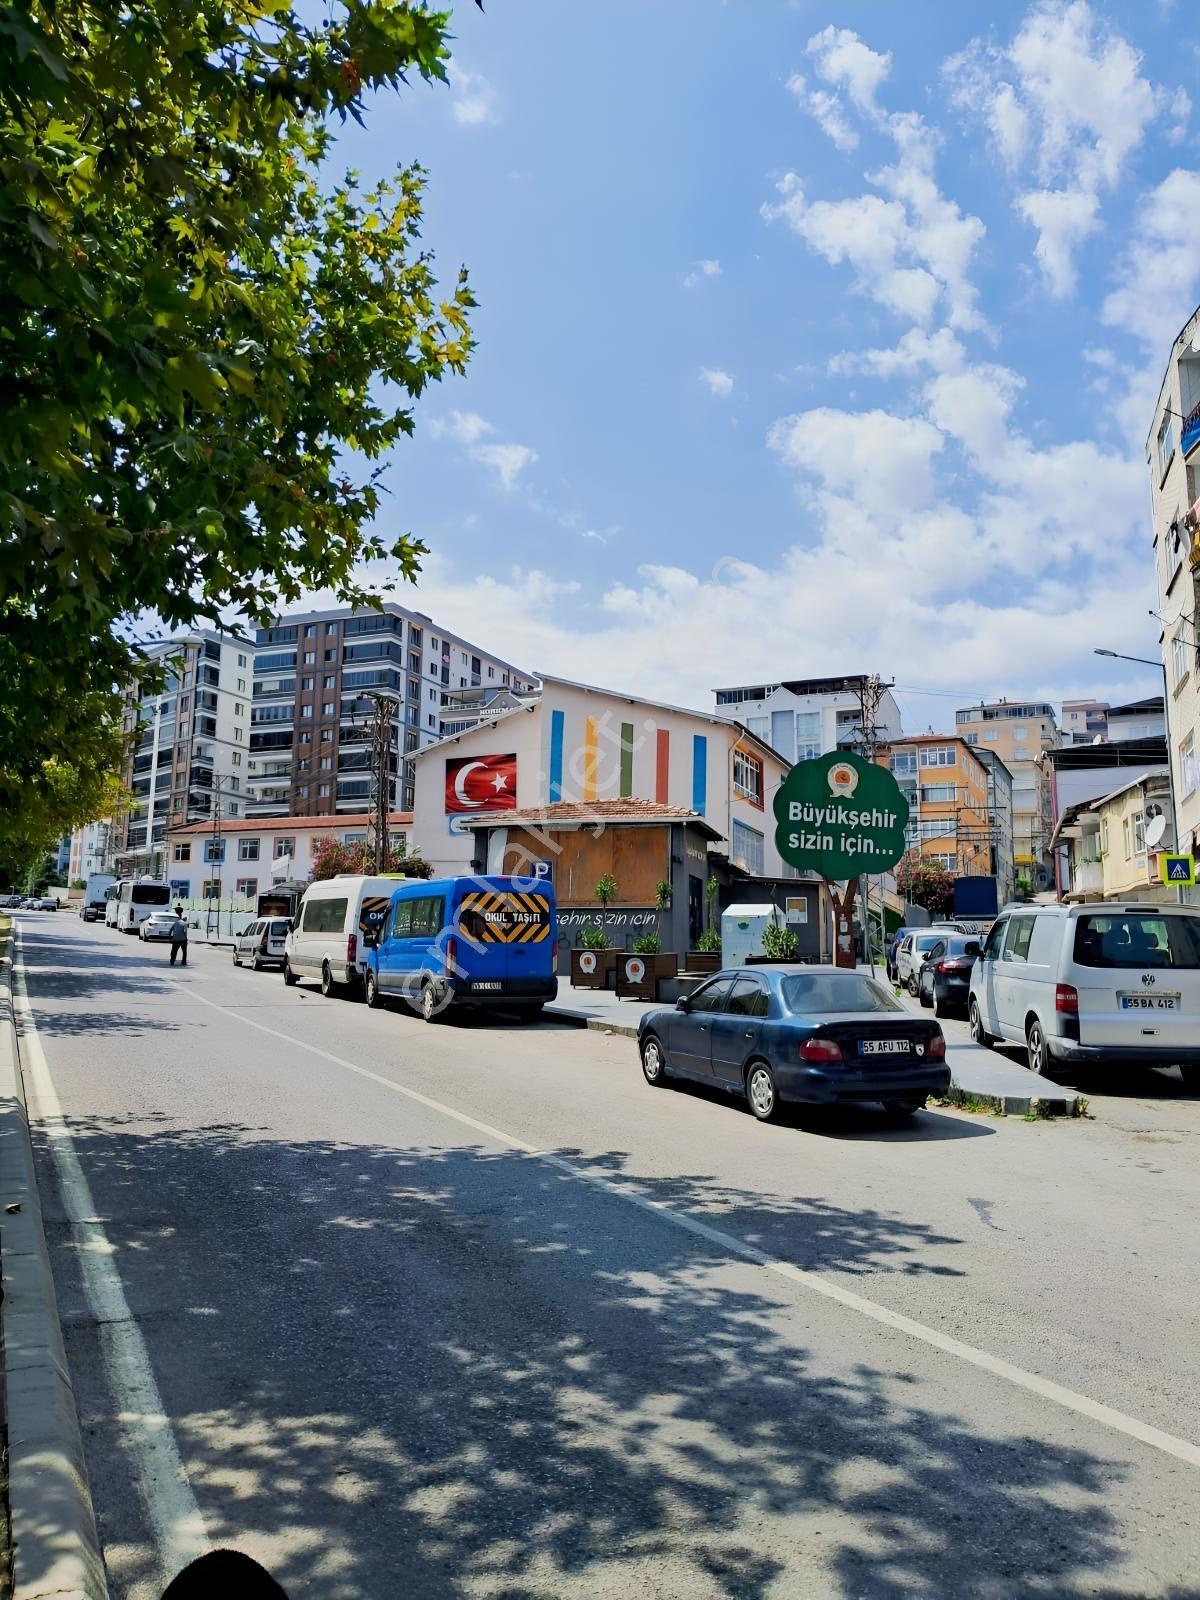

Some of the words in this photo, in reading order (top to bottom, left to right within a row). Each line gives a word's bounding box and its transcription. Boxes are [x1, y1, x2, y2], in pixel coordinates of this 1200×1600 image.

[788, 801, 897, 830] Büyükşehir
[788, 830, 834, 851] sizin
[840, 833, 894, 857] için...
[534, 863, 549, 878] P
[369, 912, 384, 920] OK
[484, 912, 508, 922] OKUL
[1127, 998, 1140, 1008] 55
[1141, 999, 1154, 1009] BA
[1157, 999, 1175, 1009] 412
[863, 1041, 874, 1052] 55
[877, 1040, 894, 1052] AFU
[896, 1040, 909, 1051] 112
